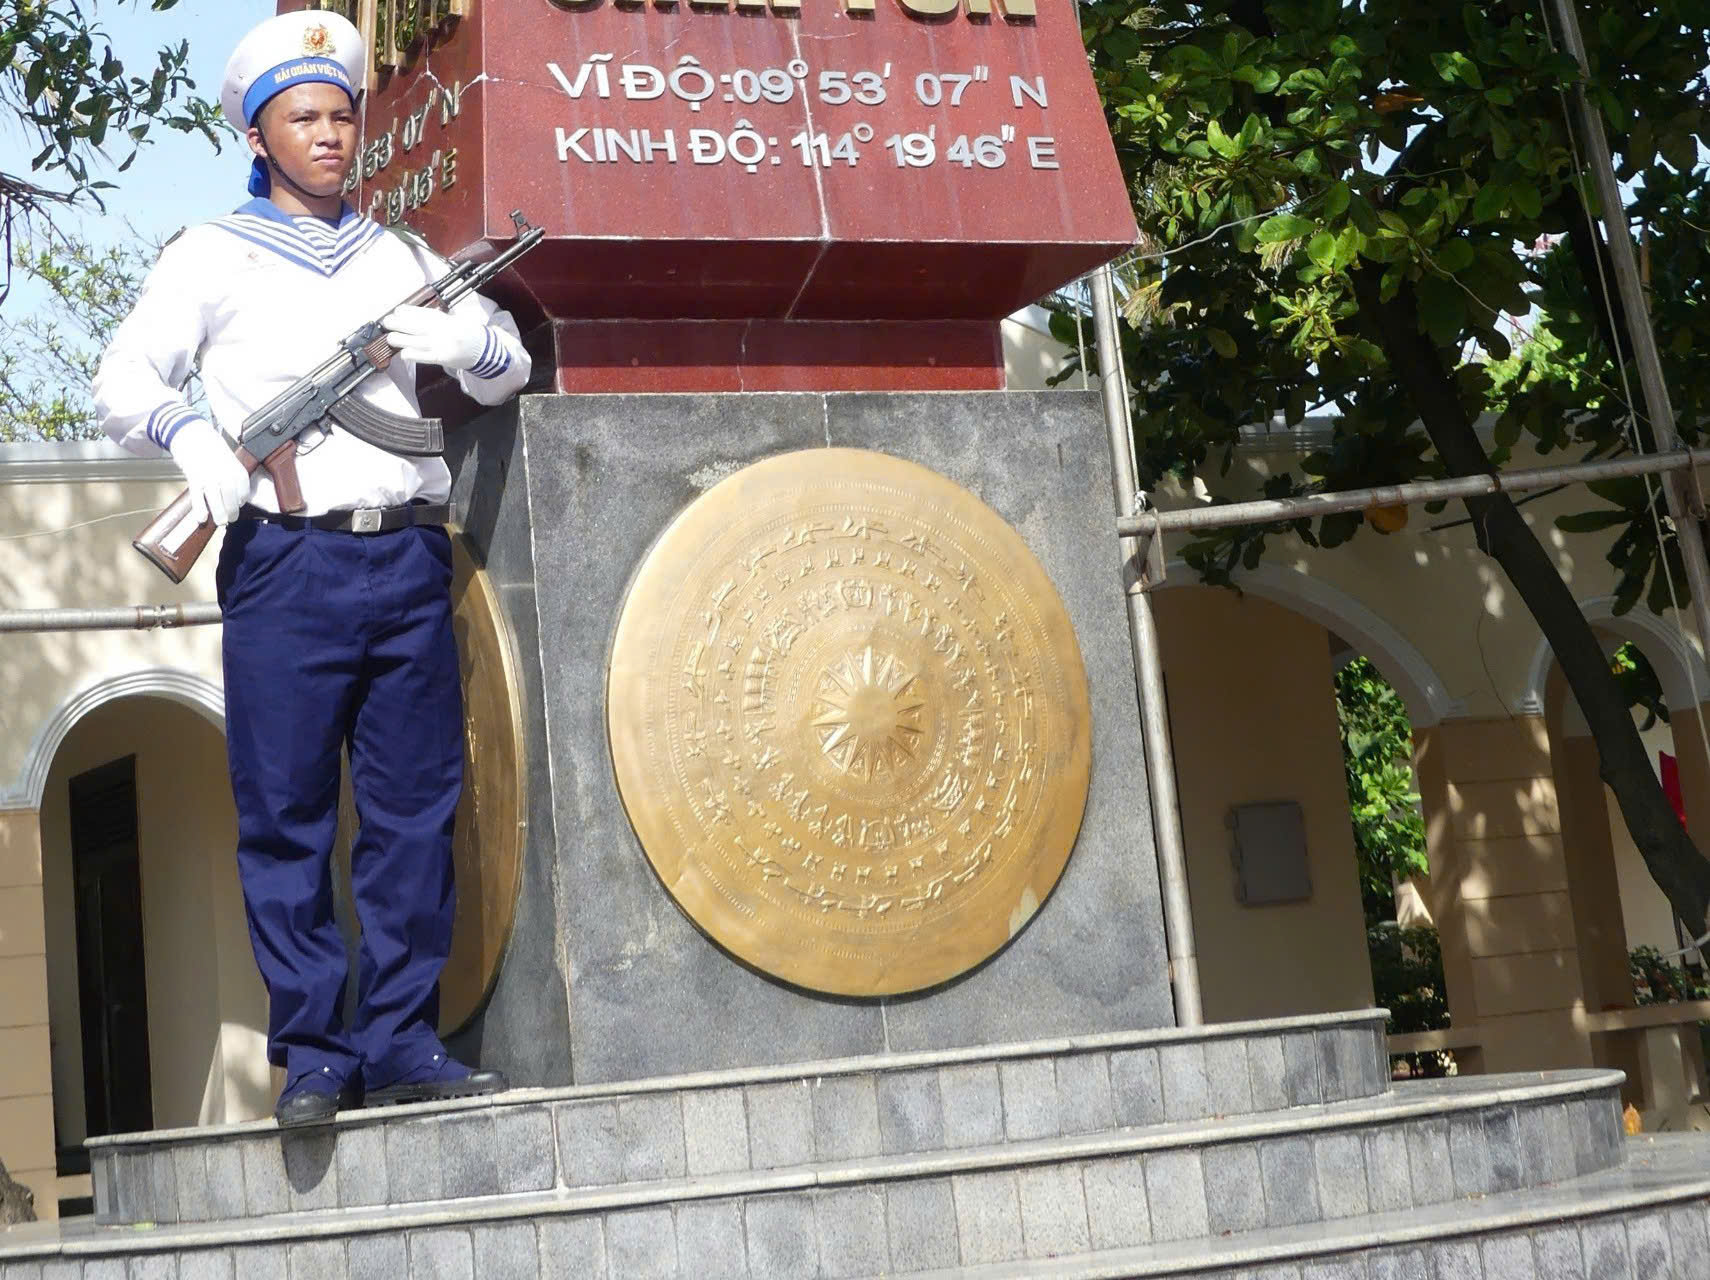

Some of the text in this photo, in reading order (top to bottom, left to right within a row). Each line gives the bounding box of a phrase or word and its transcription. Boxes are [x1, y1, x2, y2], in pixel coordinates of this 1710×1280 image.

[546, 52, 613, 99] VĨ
[819, 62, 891, 105] 53'
[915, 65, 988, 107] 07"
[1009, 75, 1048, 107] N
[441, 80, 460, 126] N
[442, 147, 457, 189] E
[554, 127, 678, 163] KINH
[1027, 136, 1060, 170] E
